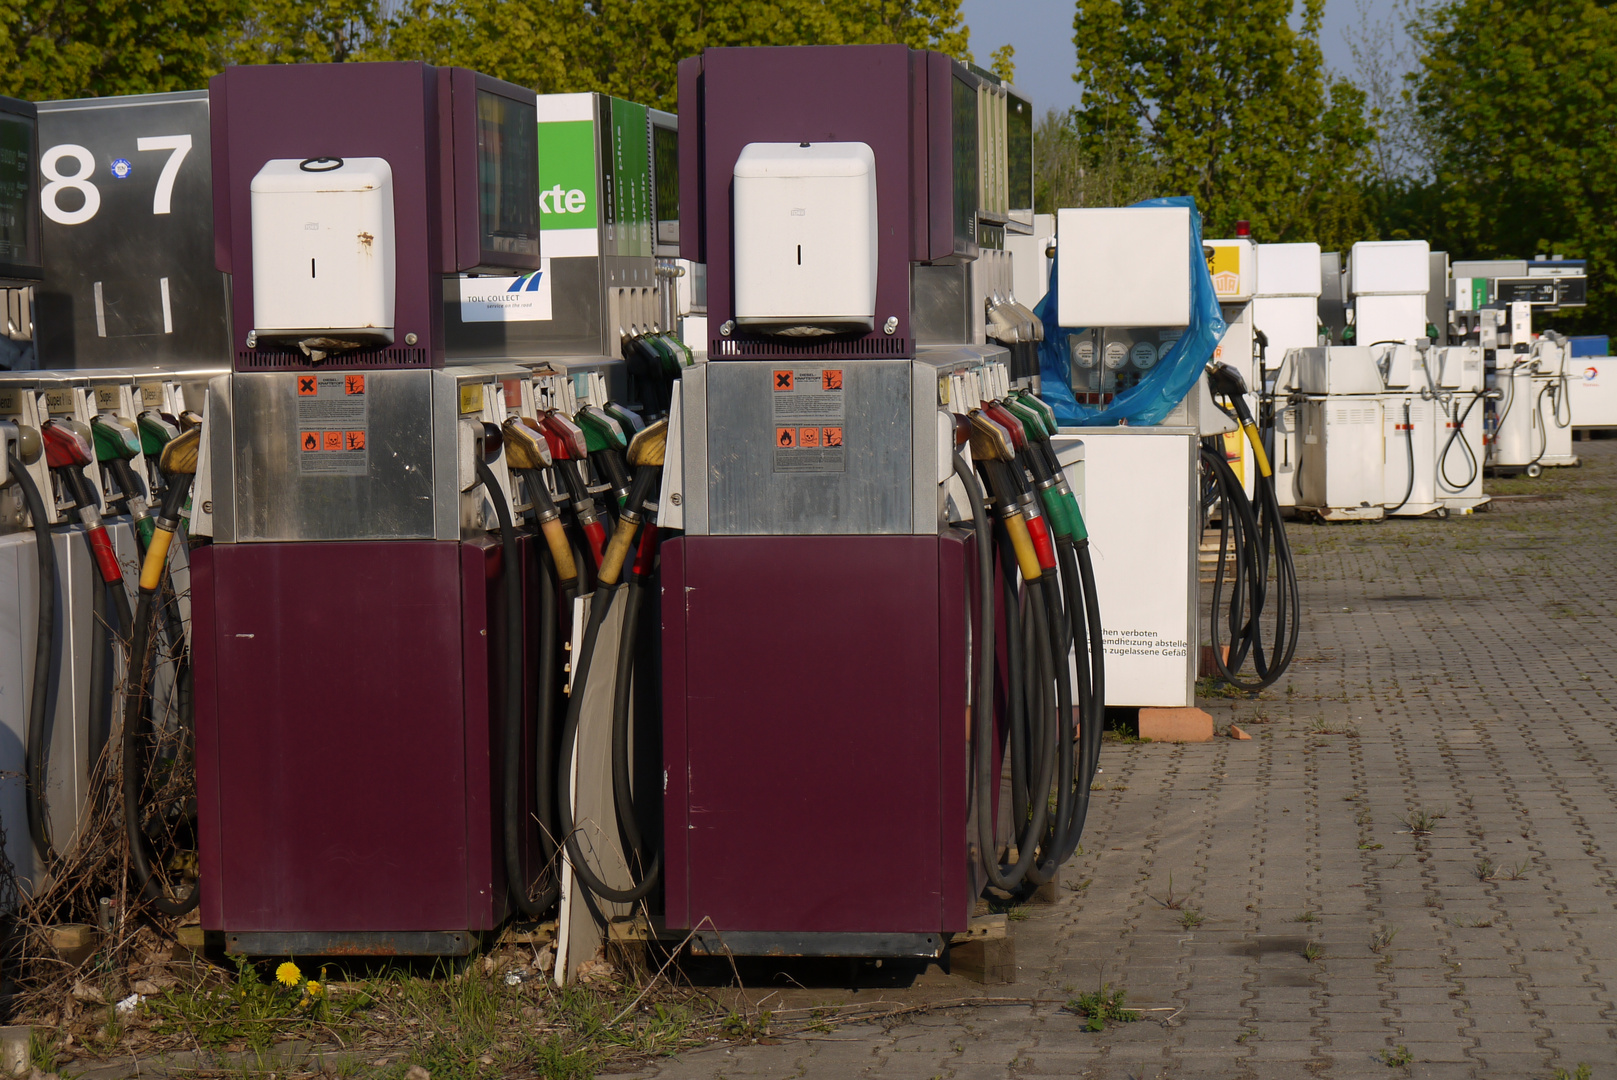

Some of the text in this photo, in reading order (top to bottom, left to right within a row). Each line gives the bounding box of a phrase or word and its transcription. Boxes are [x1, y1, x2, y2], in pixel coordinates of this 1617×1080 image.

[137, 134, 192, 214] 7
[40, 144, 100, 225] 8
[487, 294, 520, 302] COLLECT
[1120, 629, 1158, 637] verboten
[1102, 638, 1153, 648] emdheizung
[1109, 647, 1160, 656] zugelassene
